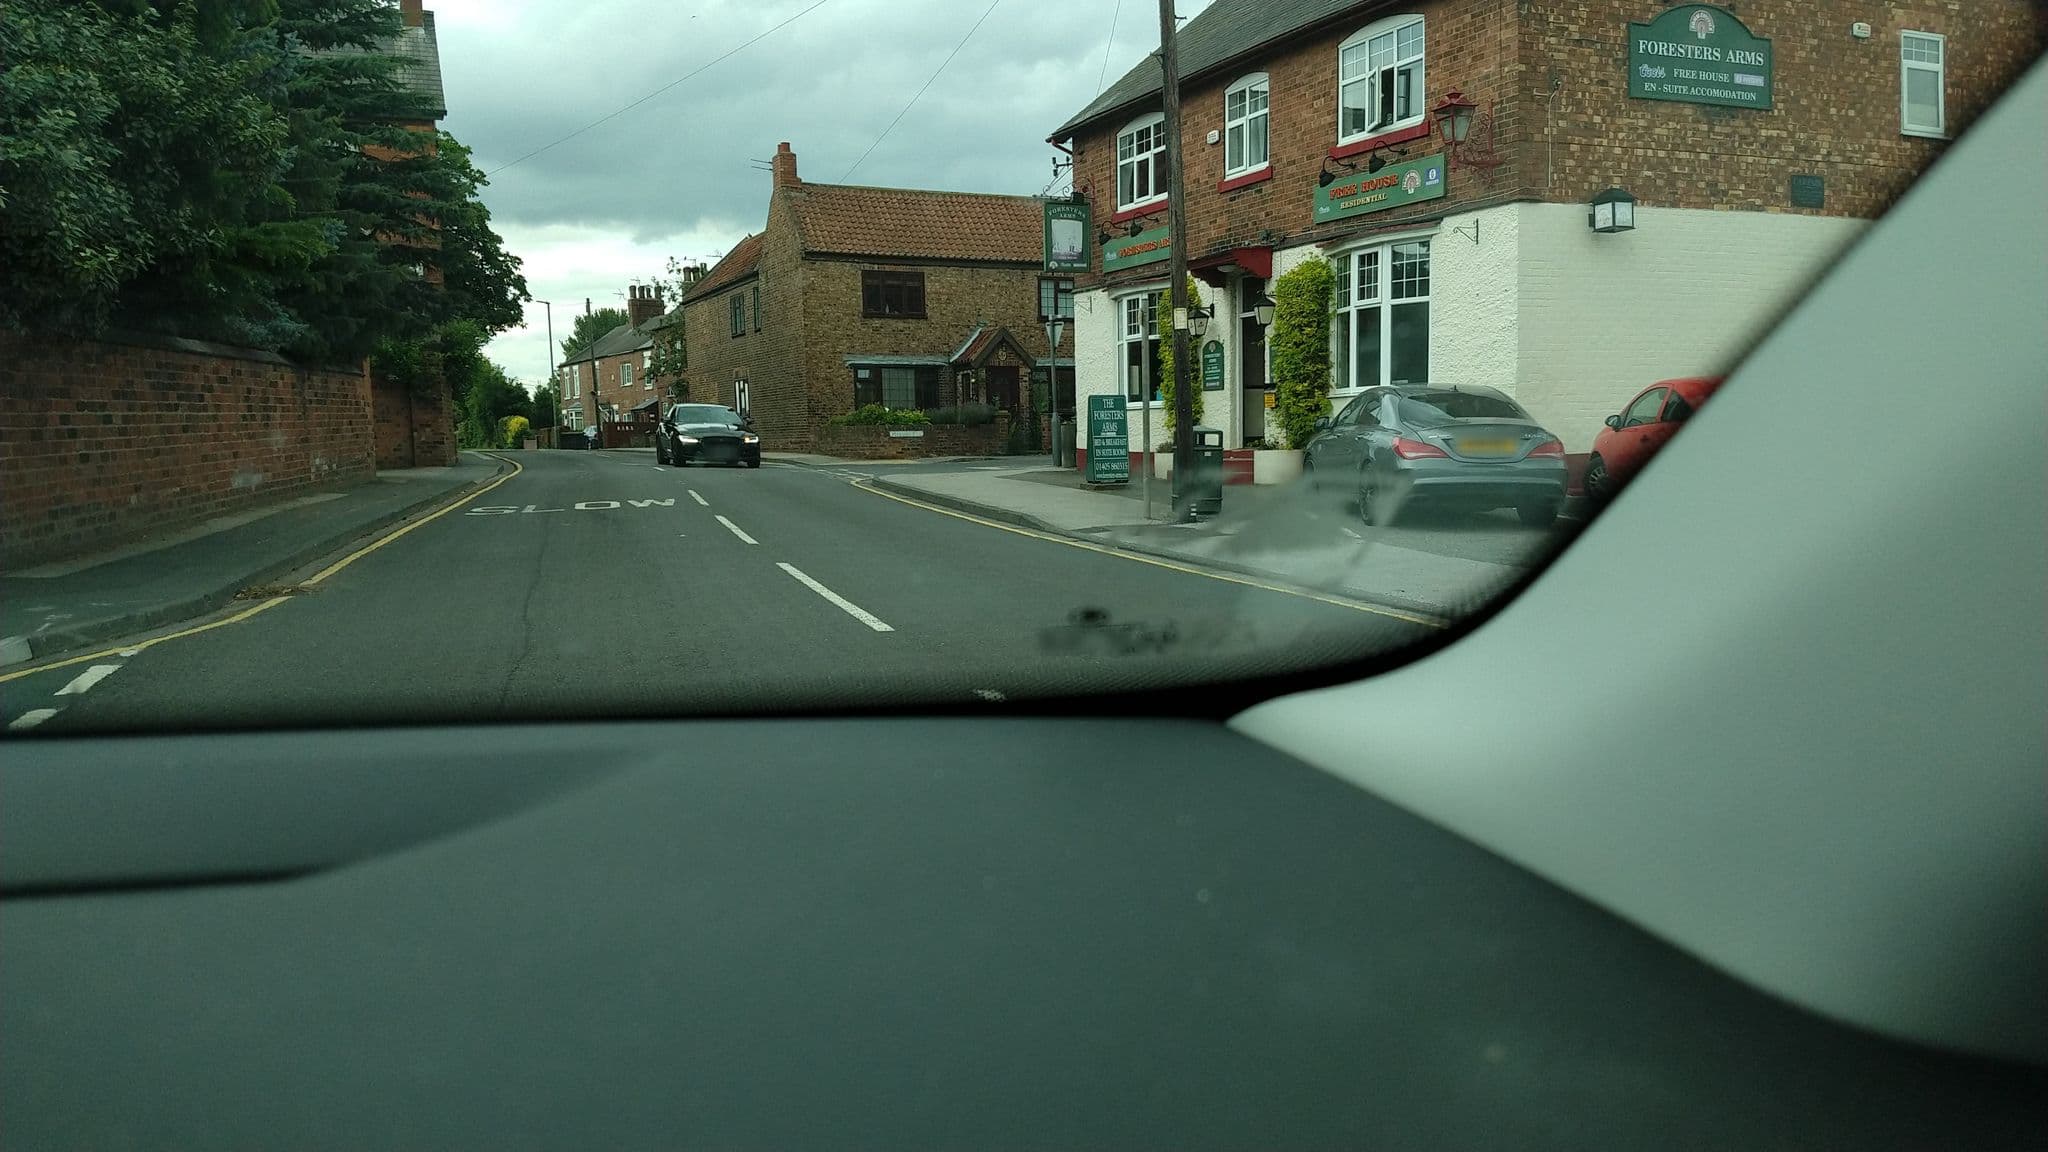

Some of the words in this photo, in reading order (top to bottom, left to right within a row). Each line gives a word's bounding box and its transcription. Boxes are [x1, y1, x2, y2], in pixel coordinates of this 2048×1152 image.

[1638, 39, 1721, 62] FORESTERS
[1726, 50, 1764, 66] ARMS
[1673, 68, 1697, 80] FREE
[1699, 71, 1730, 83] HOUSE
[1644, 82, 1656, 92] EN
[1662, 84, 1688, 96] SUITE
[1690, 87, 1757, 101] ACCOMODATION
[1329, 184, 1357, 199] FREE
[1361, 175, 1399, 192] HOUSE
[1340, 194, 1386, 208] RESIDENTIAL
[1048, 206, 1086, 219] FORESTERS
[1103, 399, 1114, 408] THE
[1093, 410, 1125, 420] FORESTERS
[1102, 422, 1118, 432] ARMS
[464, 498, 676, 516] SLOW
